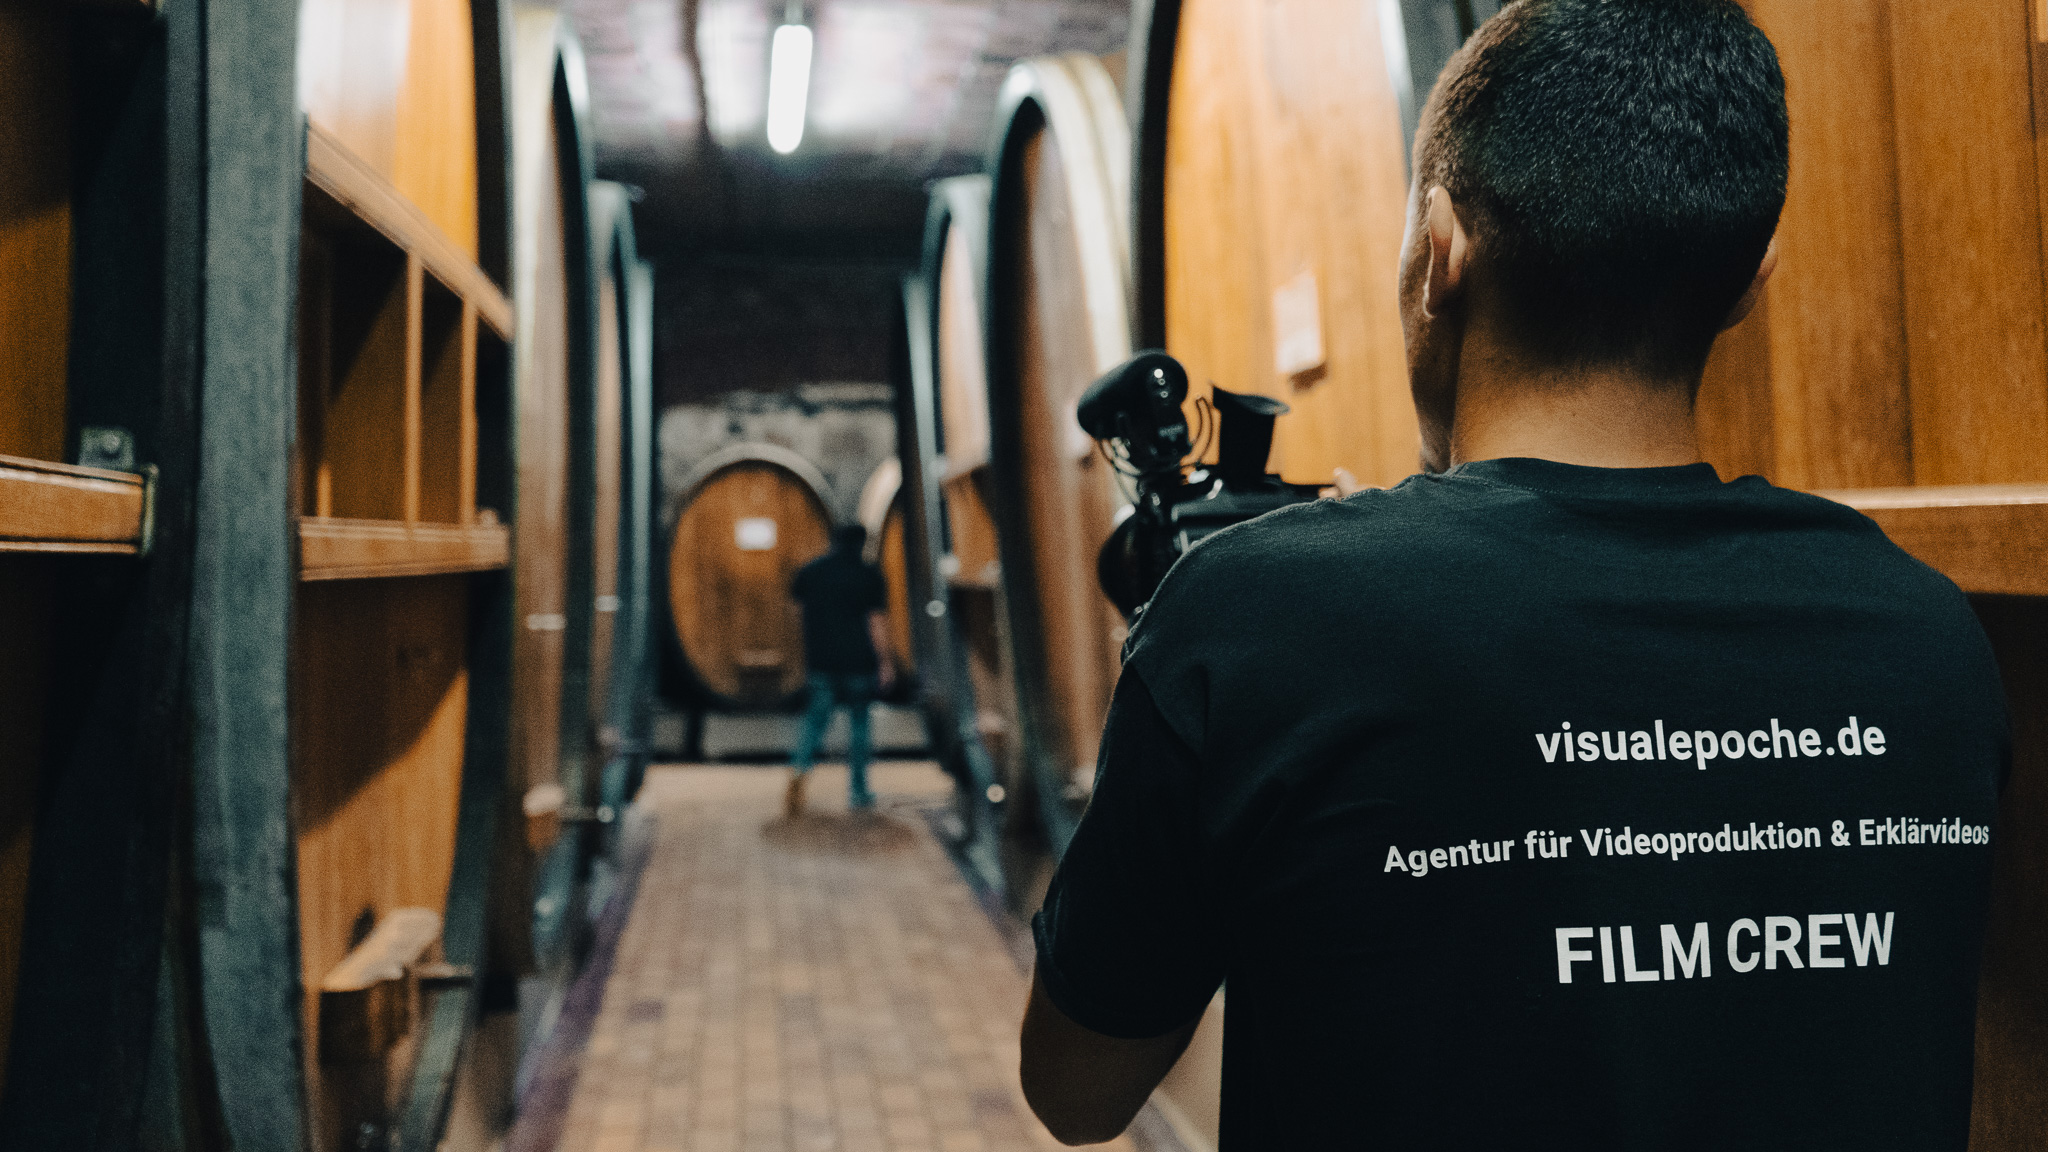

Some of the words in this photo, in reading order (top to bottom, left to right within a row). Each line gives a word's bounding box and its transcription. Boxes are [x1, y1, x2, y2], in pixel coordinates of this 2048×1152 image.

[1535, 715, 1887, 771] visualepoche.de
[1383, 839, 1515, 878] Agentur
[1523, 829, 1573, 860] für
[1579, 821, 1822, 862] Videoproduktion
[1830, 819, 1851, 847] &
[1859, 816, 1990, 846] Erklärvideos
[1555, 921, 1712, 984] FILM
[1727, 911, 1896, 973] CREW
